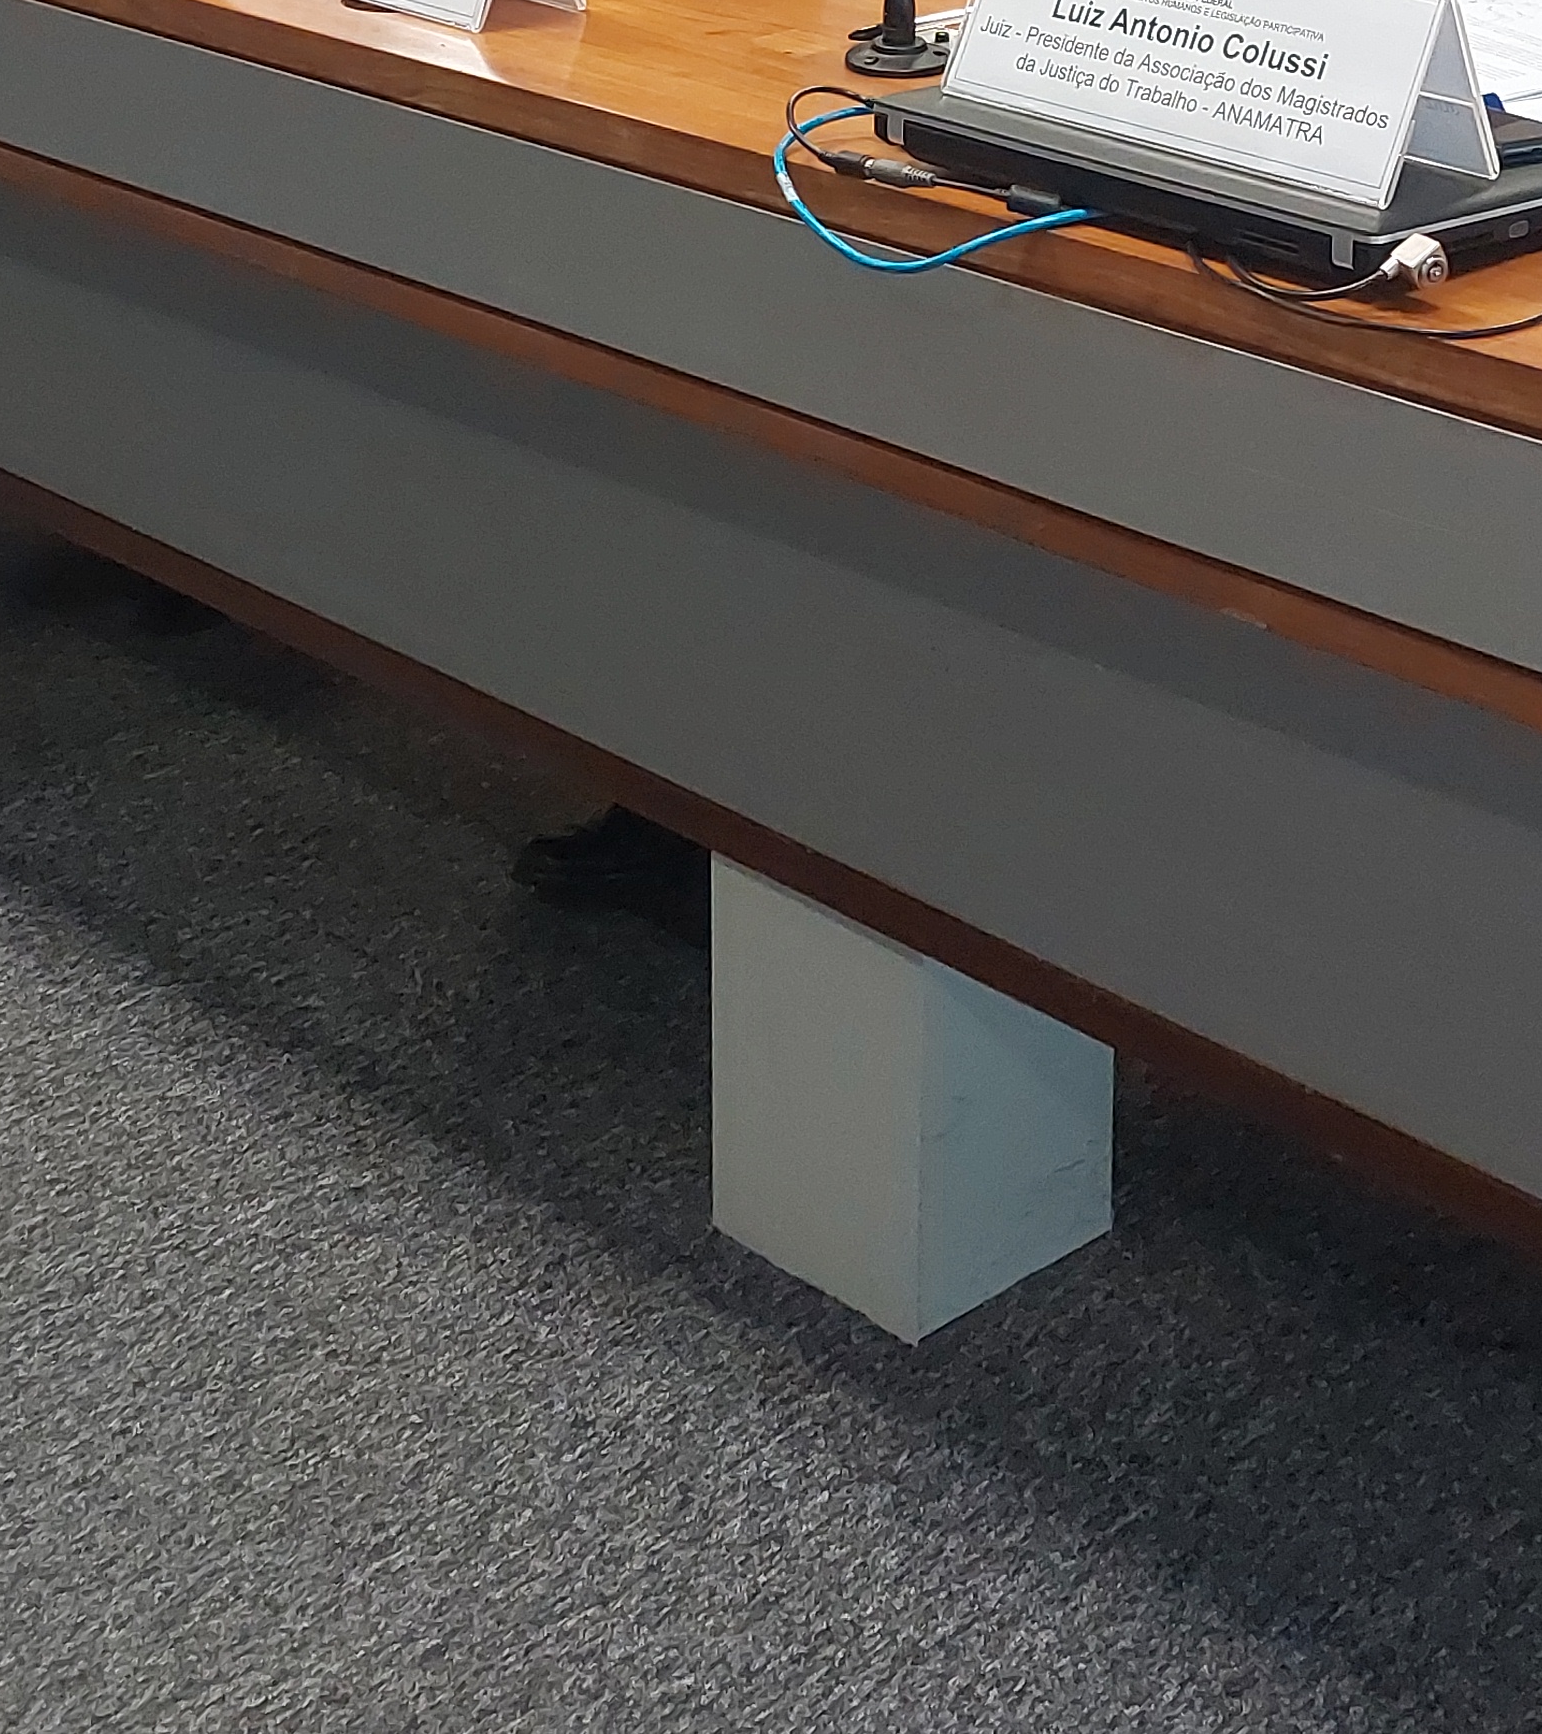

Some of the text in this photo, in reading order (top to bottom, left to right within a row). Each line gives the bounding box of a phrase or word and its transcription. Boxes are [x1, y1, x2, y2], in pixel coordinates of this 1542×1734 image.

[980, 15, 1013, 39] Juiz
[1025, 27, 1110, 62] Presidente
[1114, 45, 1134, 69] da
[1138, 51, 1237, 92] Associação
[1240, 72, 1272, 99] dos
[1277, 84, 1389, 129] Magistrados
[1109, 8, 1215, 53] Antonio
[1223, 32, 1329, 81] Colussi
[1016, 52, 1036, 73] da
[1039, 59, 1095, 88] Justiça
[1099, 70, 1120, 94] do
[1125, 78, 1198, 113] Trabalho
[1211, 101, 1325, 146] ANAMATRA
